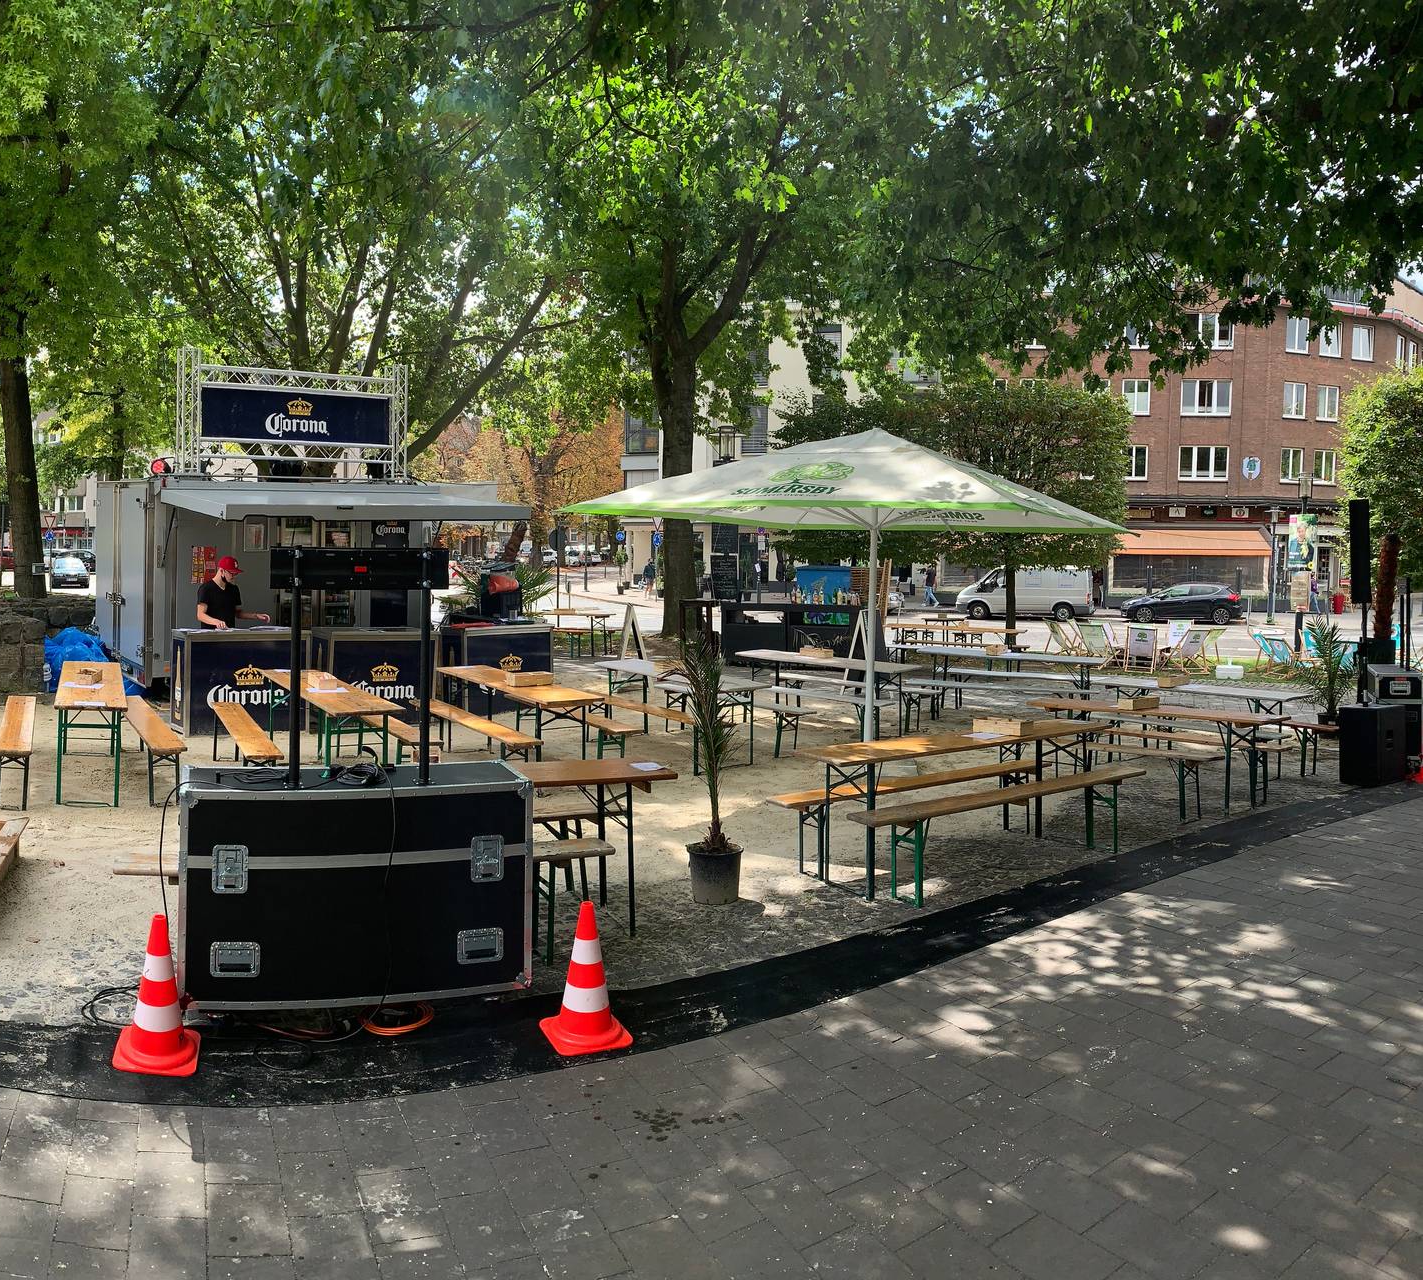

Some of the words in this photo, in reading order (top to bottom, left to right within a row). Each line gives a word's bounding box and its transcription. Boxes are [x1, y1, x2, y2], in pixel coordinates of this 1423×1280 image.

[265, 412, 329, 438] Corona
[734, 484, 841, 495] SOMERSBY
[375, 524, 406, 536] Corona
